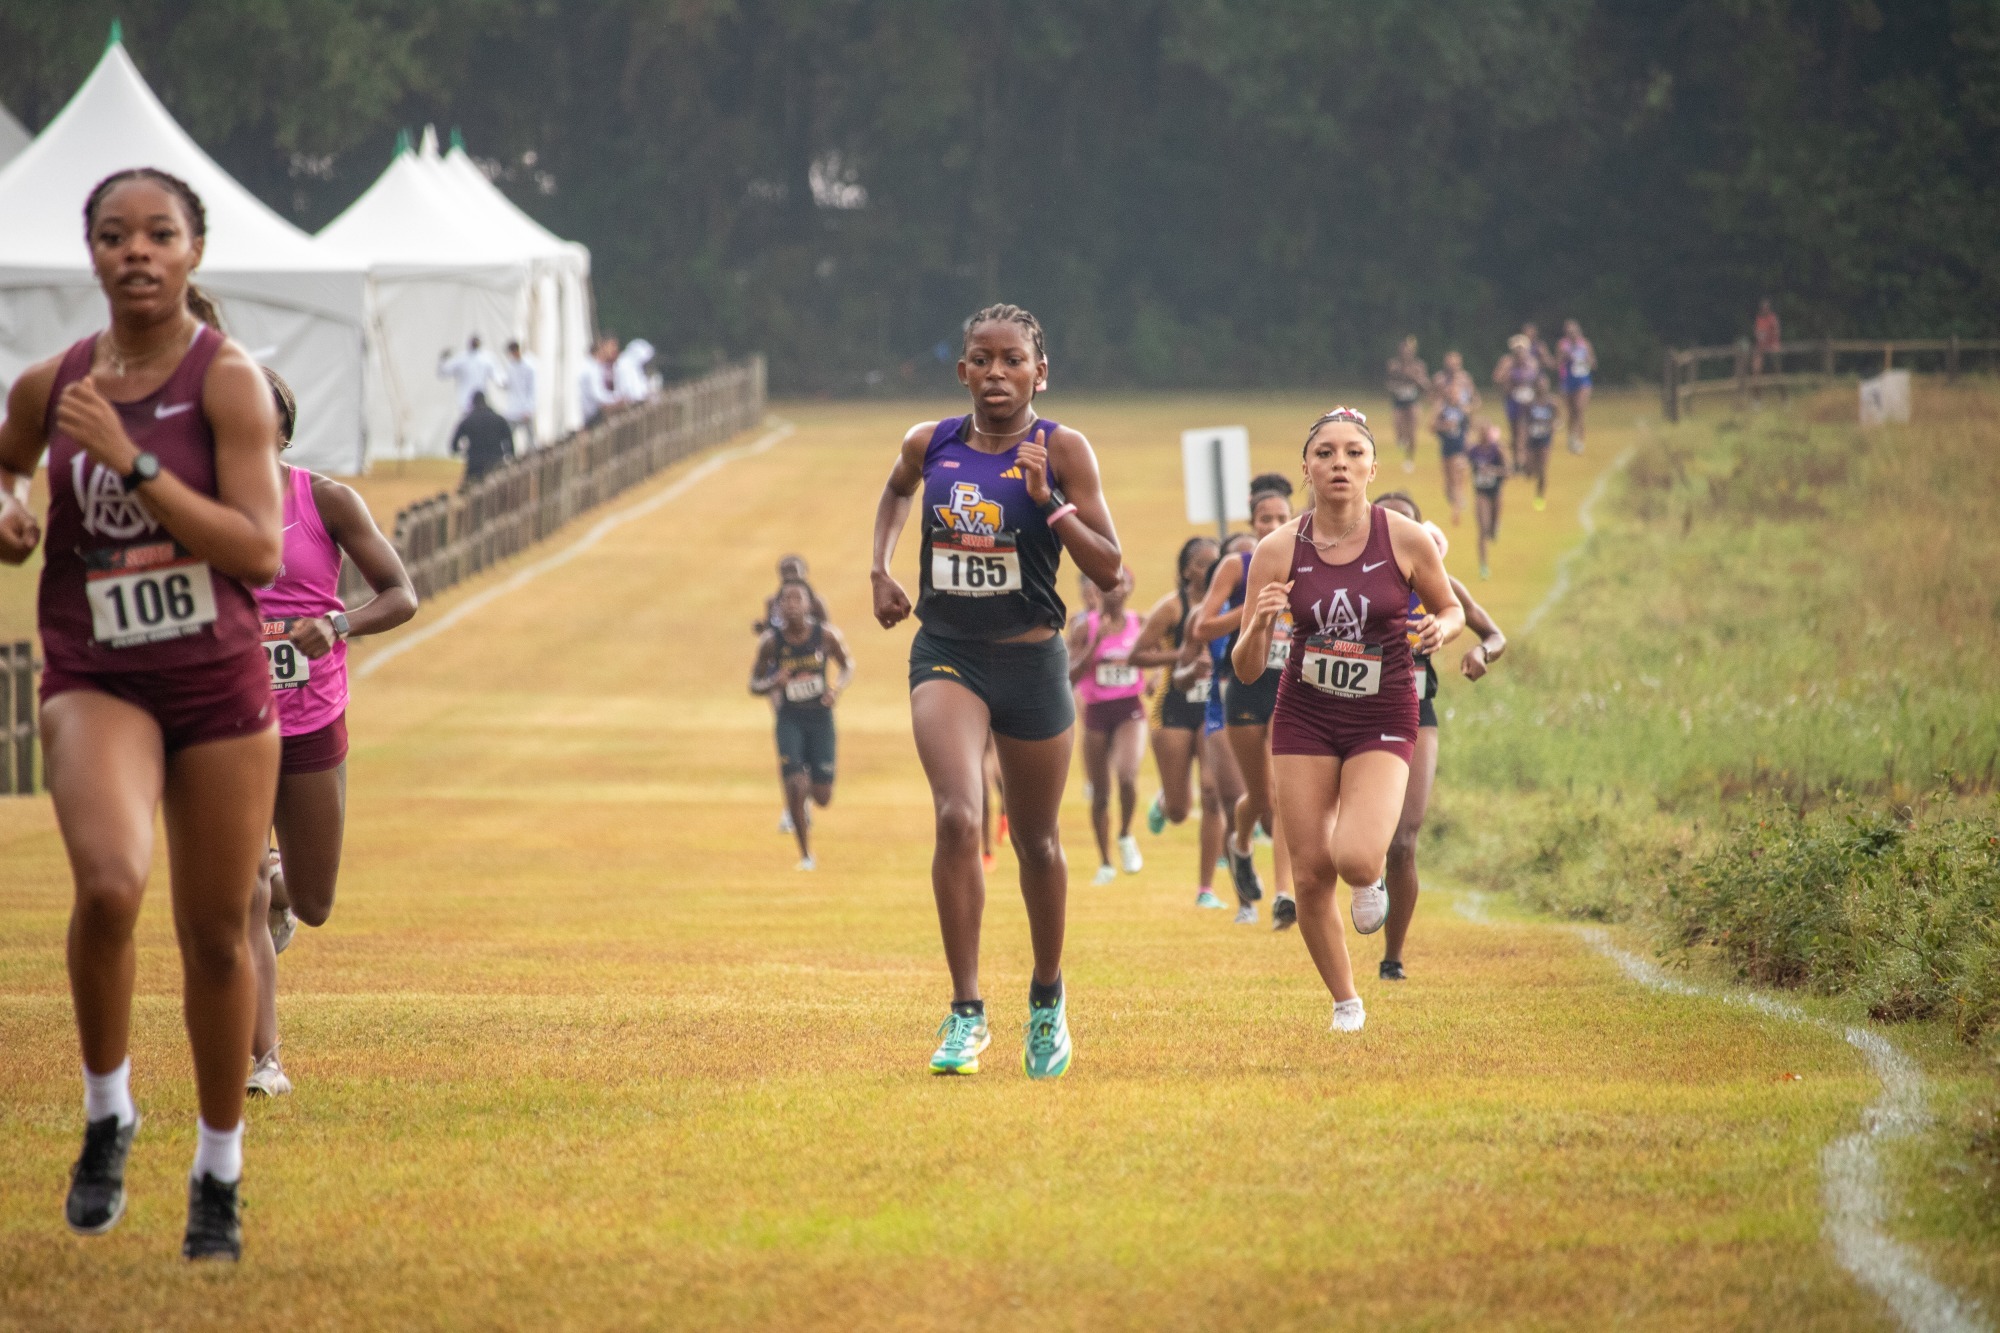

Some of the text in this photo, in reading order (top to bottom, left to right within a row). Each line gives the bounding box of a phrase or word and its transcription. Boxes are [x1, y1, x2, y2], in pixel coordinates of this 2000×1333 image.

[947, 553, 1008, 588] 165
[105, 573, 195, 631] 106
[1314, 657, 1369, 692] 102
